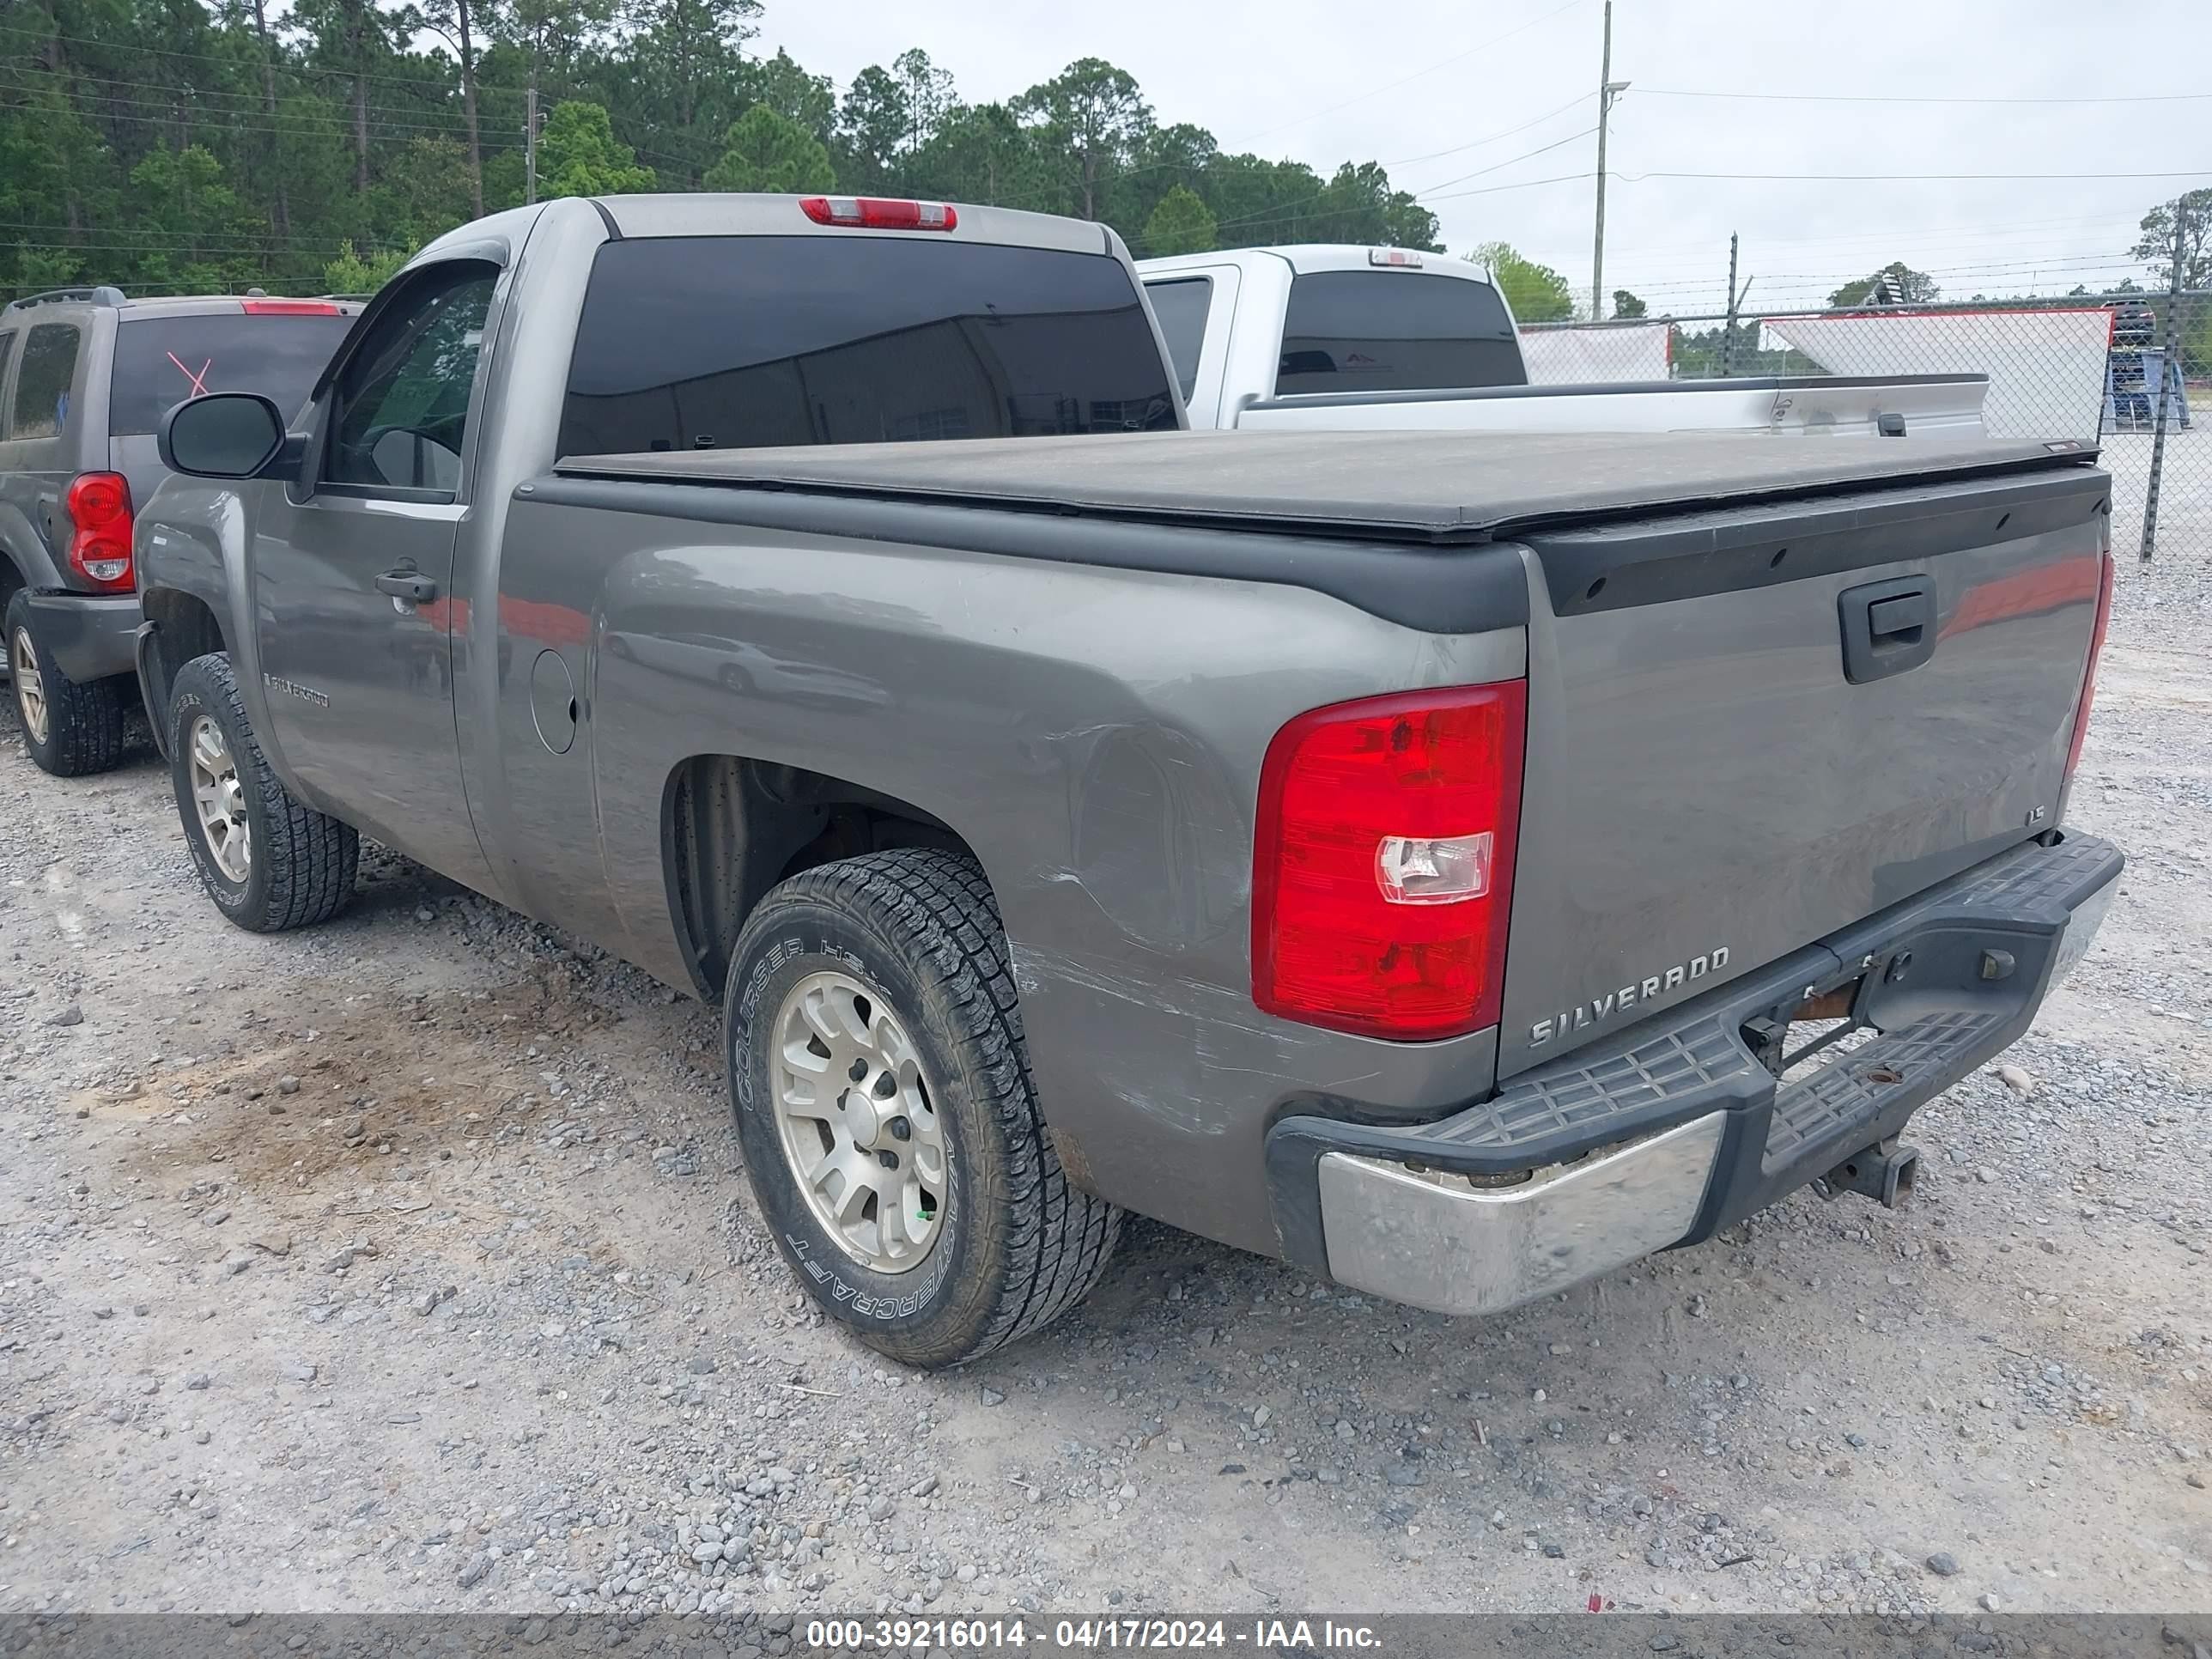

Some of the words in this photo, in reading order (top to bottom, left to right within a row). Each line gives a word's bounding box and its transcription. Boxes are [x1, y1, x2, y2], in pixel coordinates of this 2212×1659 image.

[735, 937, 805, 1112] COURSER
[820, 939, 893, 997] HSX
[1527, 945, 1730, 1050] SILVERADO
[785, 1133, 959, 1320] MASTERCRAFT
